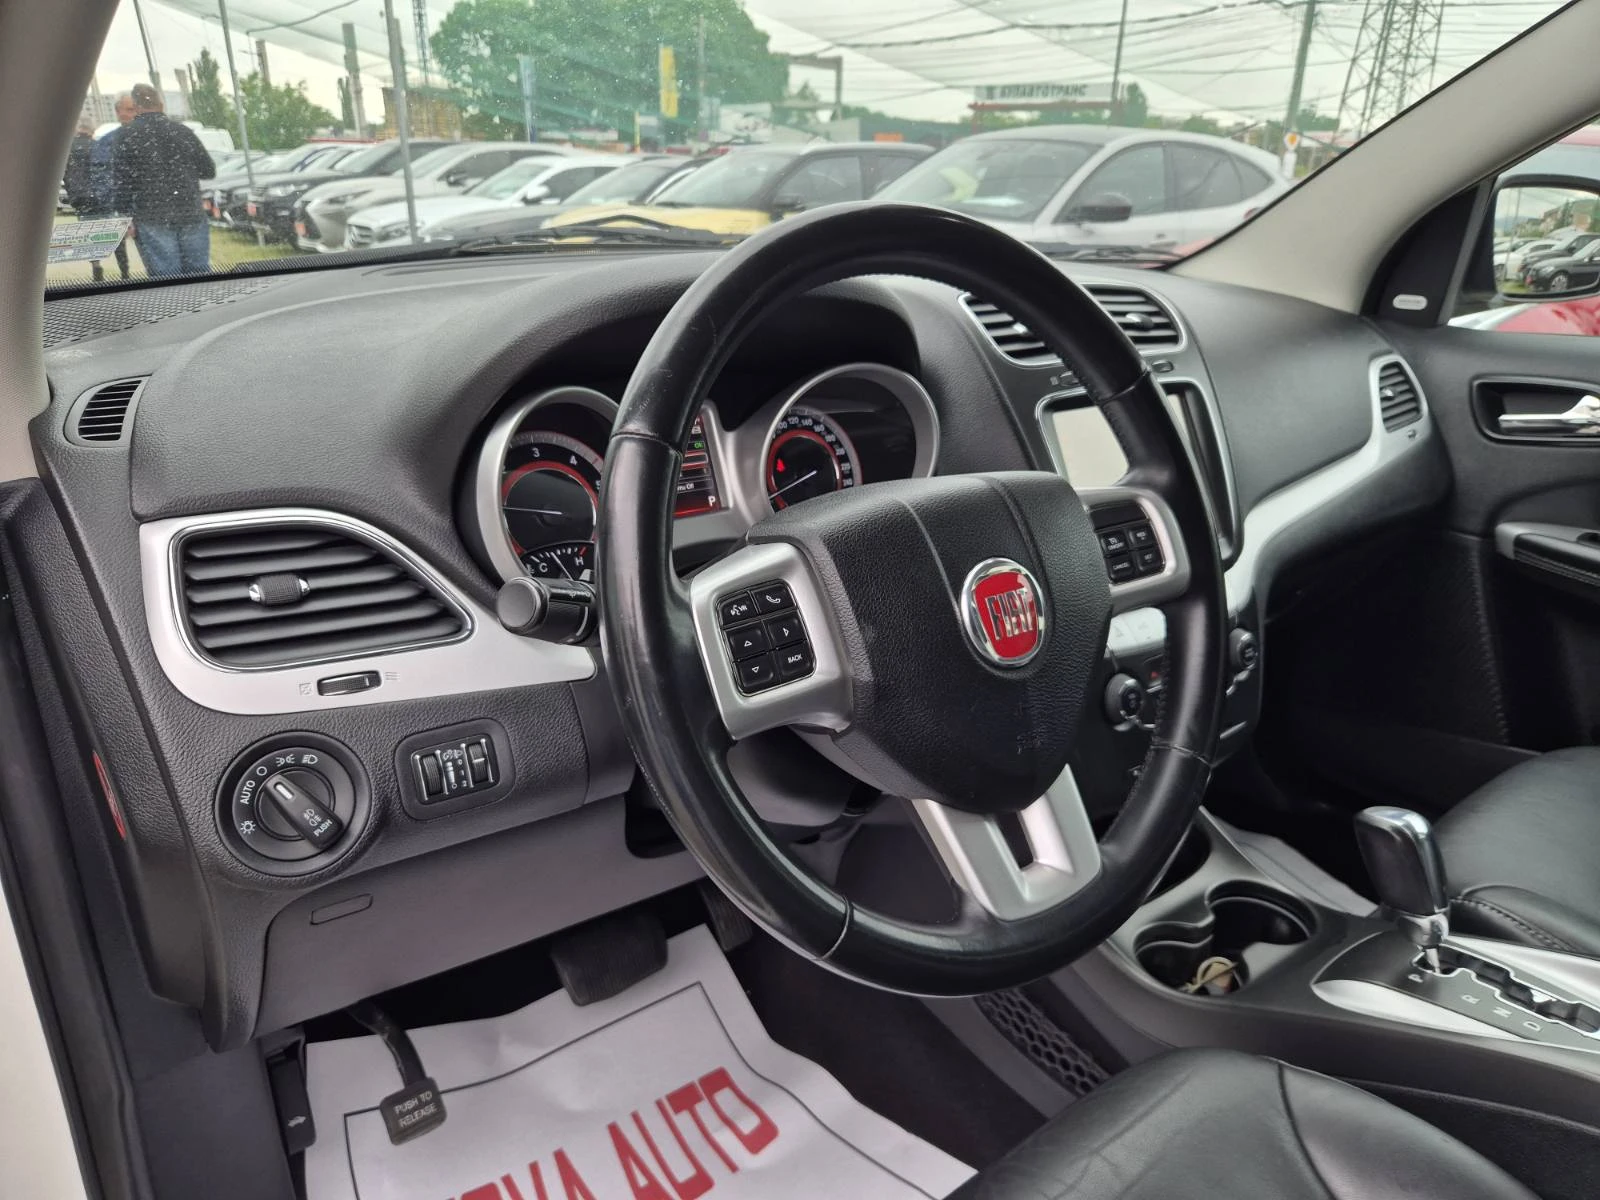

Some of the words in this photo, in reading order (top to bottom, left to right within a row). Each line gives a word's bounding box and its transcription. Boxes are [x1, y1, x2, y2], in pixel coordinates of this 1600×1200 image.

[531, 447, 540, 458] 3
[569, 455, 578, 466] 4
[707, 495, 716, 507] P
[539, 562, 549, 573] C
[574, 556, 584, 566] H
[985, 588, 1033, 641] FIAT
[787, 654, 803, 664] BACK
[239, 779, 256, 805] AUTO
[314, 819, 333, 836] PUSH
[394, 1097, 419, 1114] PUSH
[419, 1090, 433, 1103] TO
[400, 1102, 438, 1128] RELEASE
[607, 1066, 779, 1200] AUTO
